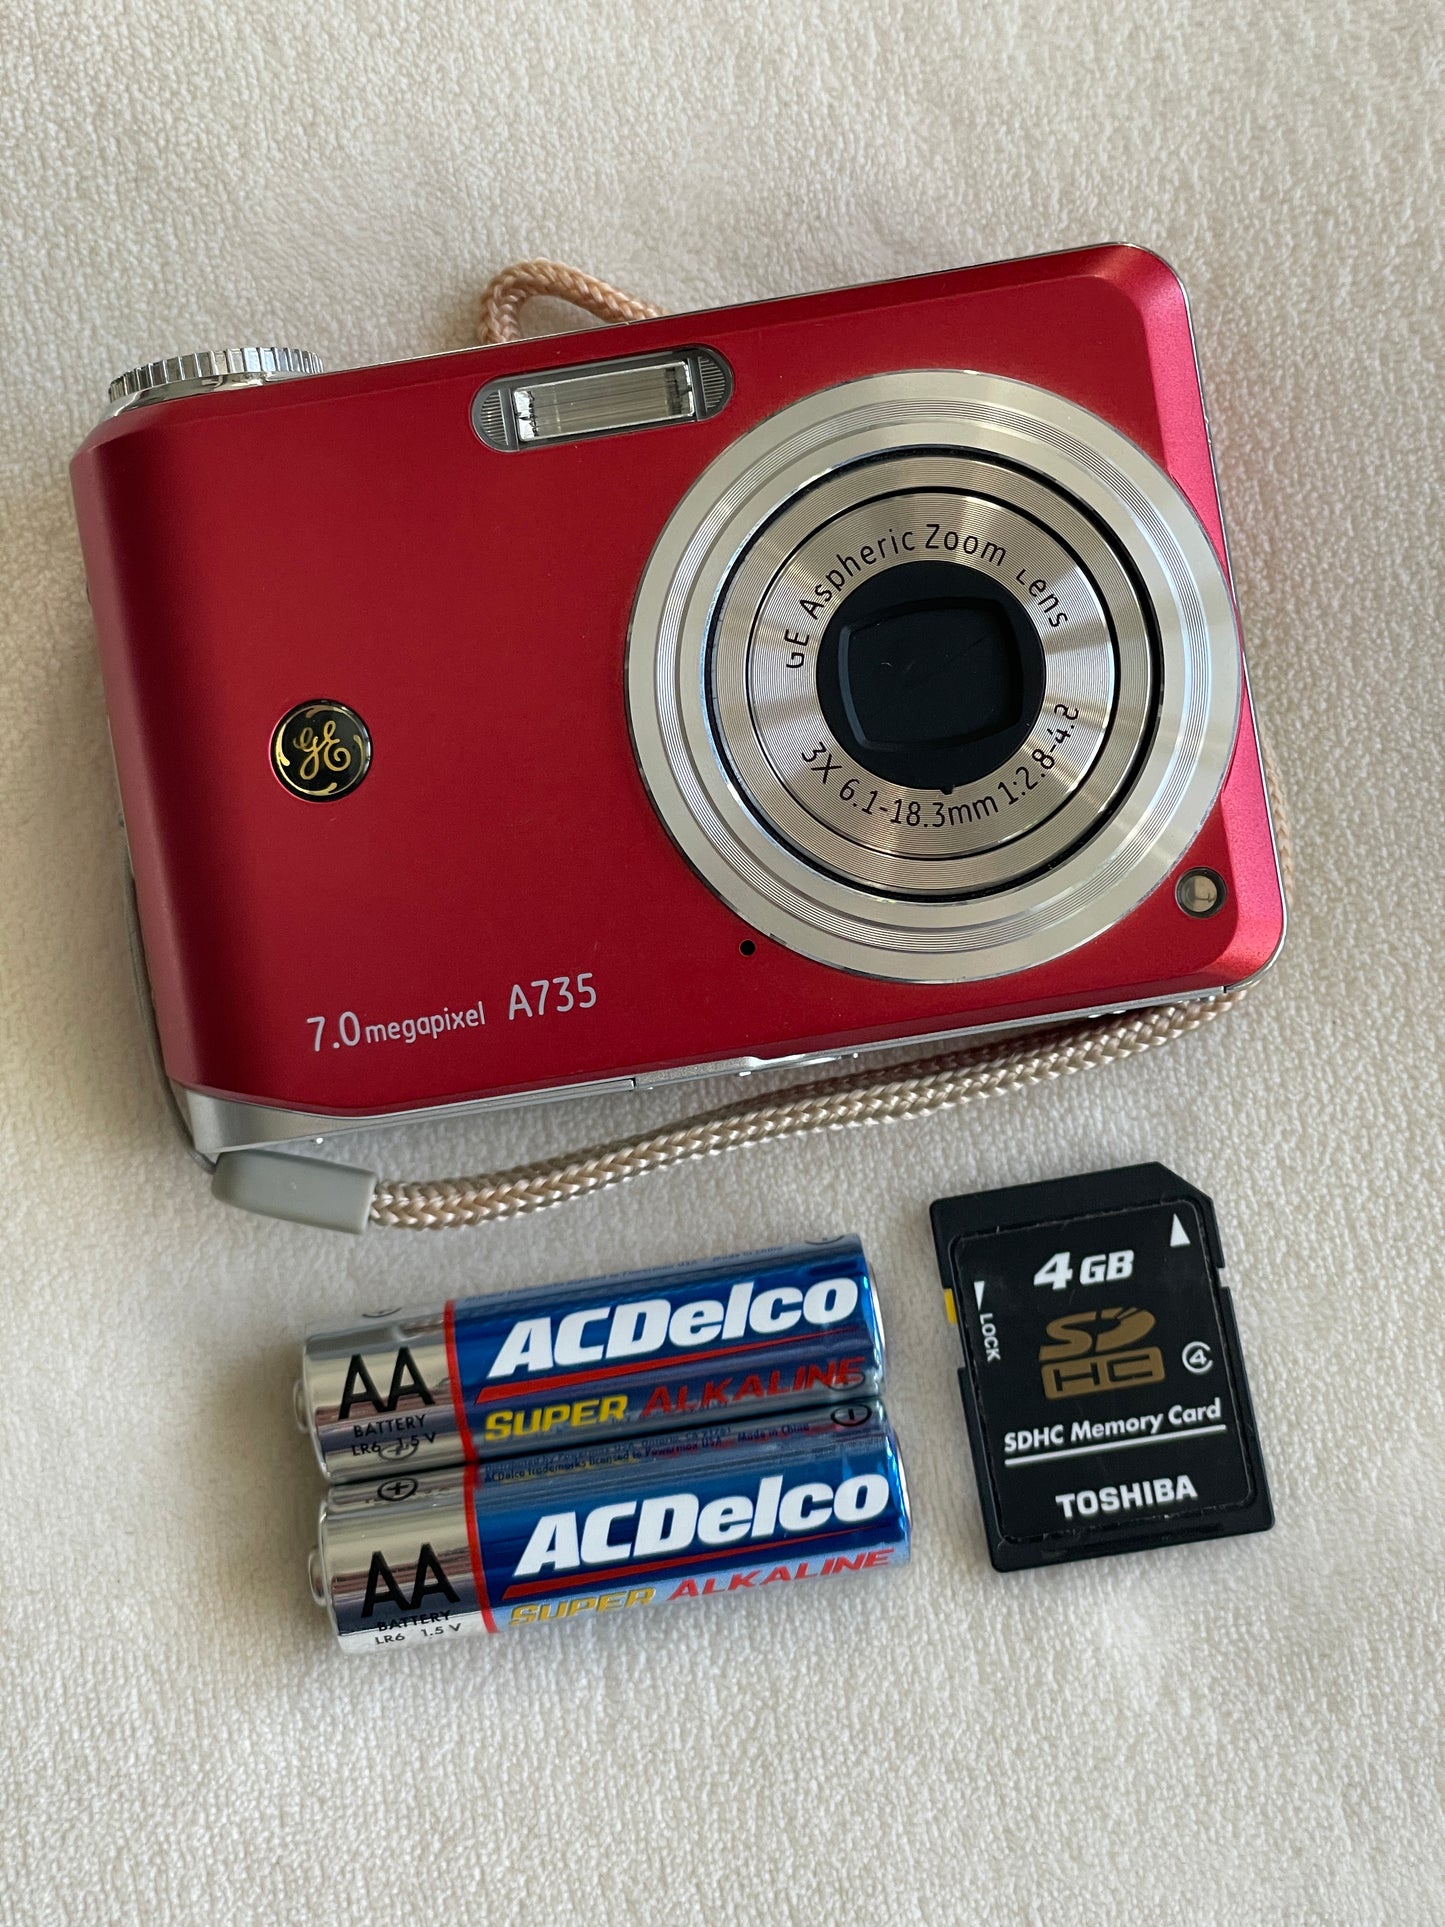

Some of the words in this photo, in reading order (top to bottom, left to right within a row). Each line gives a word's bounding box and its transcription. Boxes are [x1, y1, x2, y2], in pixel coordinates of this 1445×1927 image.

[784, 629, 810, 669] GE
[799, 528, 916, 620] Aspheric
[925, 523, 1007, 567] Zoom
[1016, 568, 1068, 628] Lens
[801, 741, 843, 785] 3X
[838, 777, 999, 828] 6.1-18.3mm
[997, 703, 1080, 806] 1:2.8-4.2
[364, 1000, 486, 1044] megapixel
[508, 972, 597, 1020] A735
[486, 1276, 858, 1380] ACDelco
[979, 1312, 1002, 1362] LOCK
[338, 1345, 436, 1421] AA
[484, 1394, 629, 1444] SUPER
[640, 1355, 867, 1419] ALKALINE
[351, 1442, 382, 1457] LR6
[423, 1431, 438, 1444] V
[353, 1414, 427, 1439] BATTERY
[1004, 1423, 1065, 1453] SDHC
[1070, 1412, 1164, 1444] Memory
[1167, 1397, 1222, 1425] Card
[513, 1472, 891, 1578] ACDelco
[1055, 1474, 1198, 1520] TOSHIBA
[360, 1541, 461, 1618] AA
[506, 1586, 657, 1628] SUPER
[669, 1547, 897, 1601] ALKALINE
[374, 1632, 406, 1645] LR6
[447, 1622, 463, 1633] V
[376, 1609, 451, 1632] BATTERY
